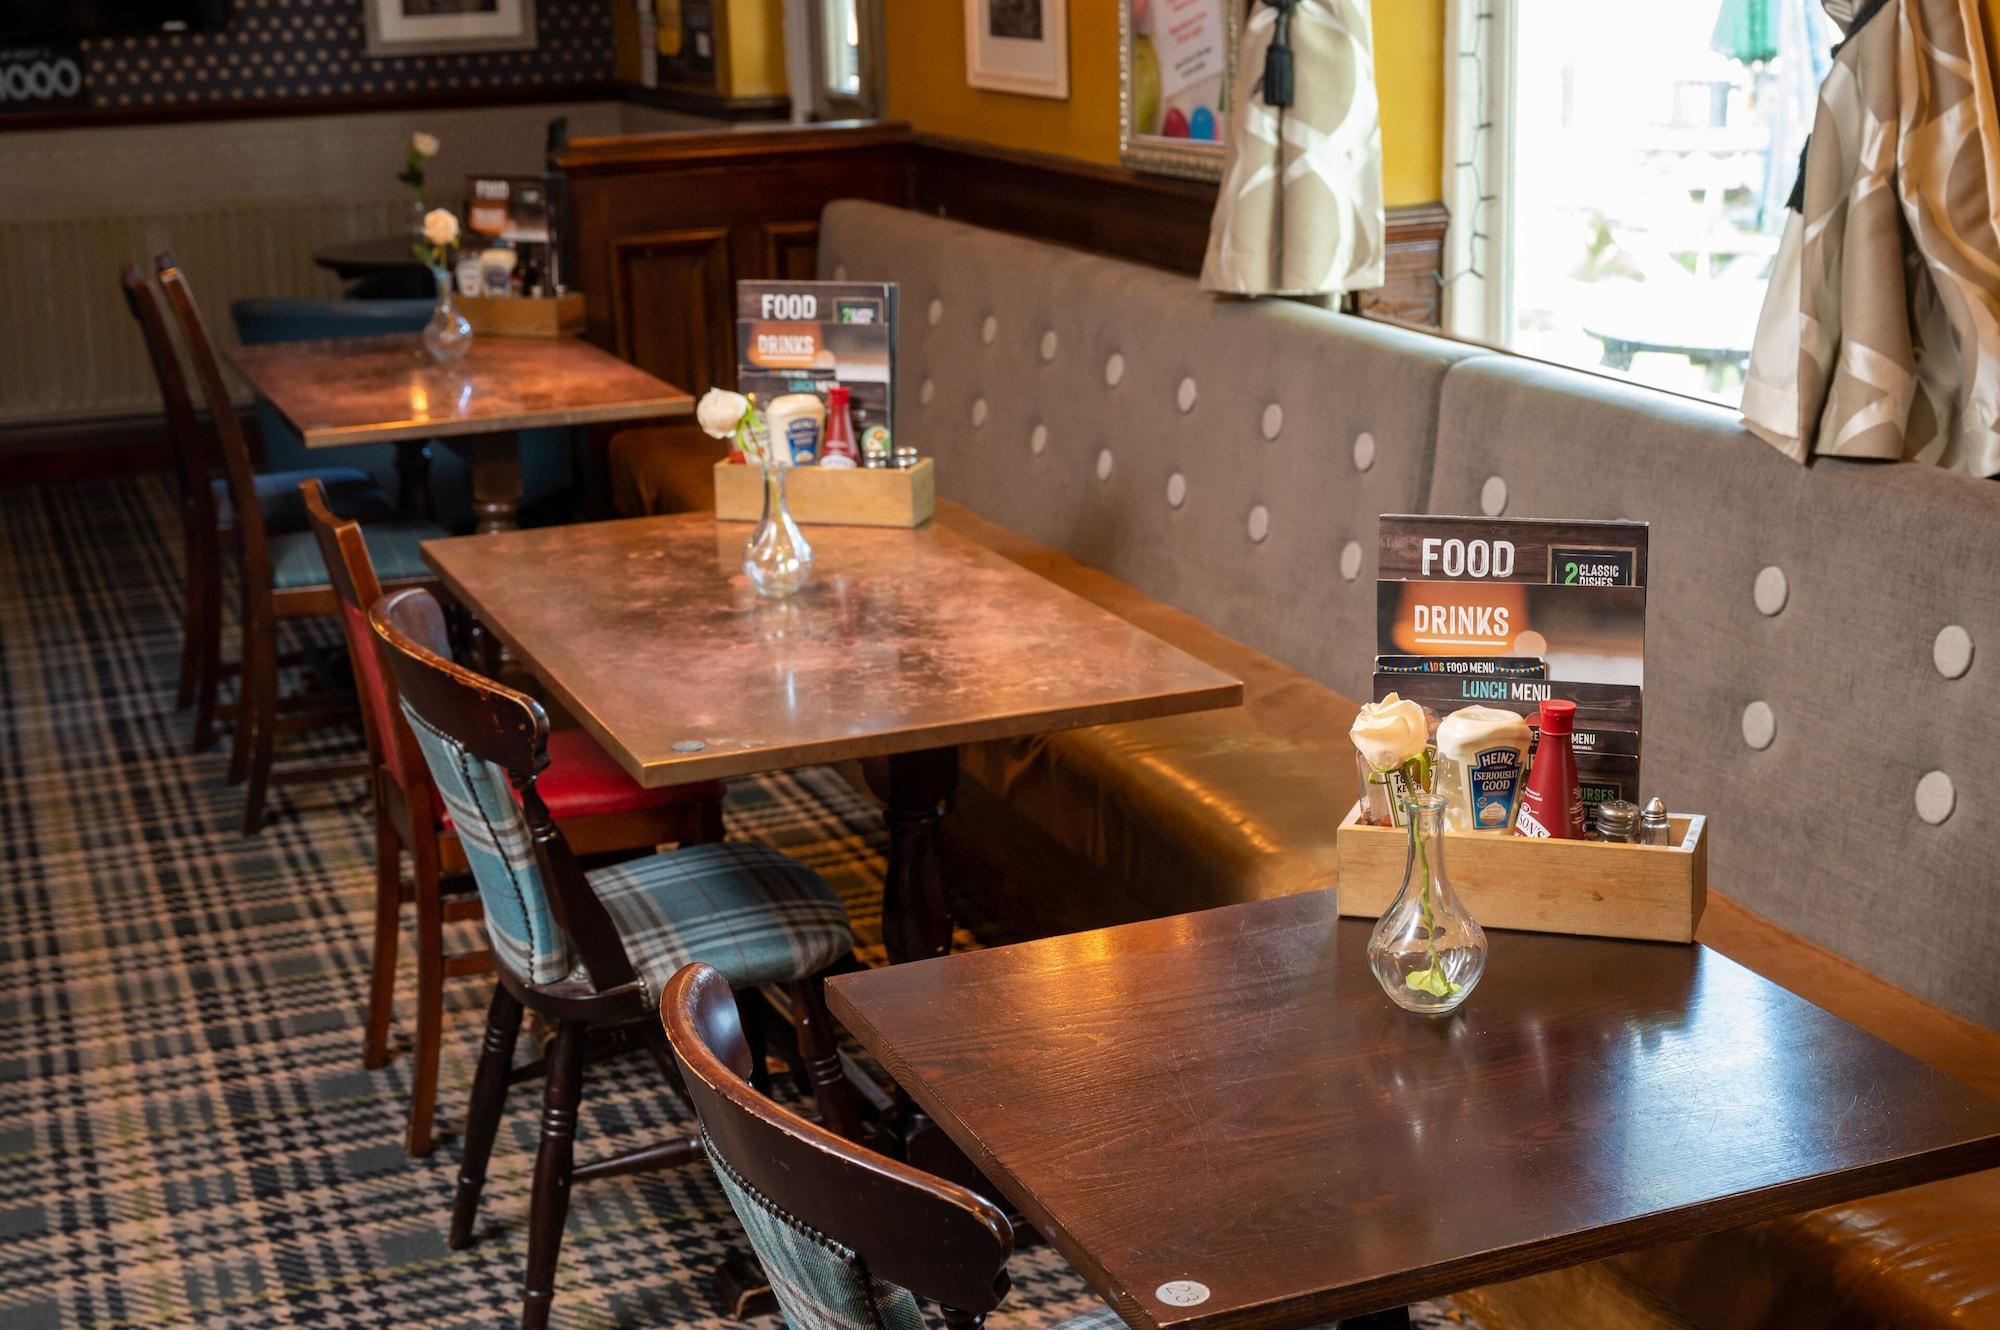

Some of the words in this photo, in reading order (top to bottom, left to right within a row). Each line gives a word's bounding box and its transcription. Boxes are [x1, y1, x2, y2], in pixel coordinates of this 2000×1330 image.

[761, 294, 818, 320] FOOD
[757, 335, 814, 355] DRINKS
[1422, 538, 1515, 578] FOOD
[1565, 562, 1579, 585] 2
[1579, 563, 1620, 578] CLASSIC
[1414, 604, 1510, 637] DRINKS
[1423, 661, 1445, 673] KIDS
[1446, 662, 1469, 674] FOOD
[1469, 662, 1495, 674] MENU
[1462, 680, 1507, 699] LUNCH
[1511, 682, 1552, 701] MENU
[1571, 732, 1596, 745] MENU
[1481, 751, 1516, 767] HEINZ
[1482, 779, 1511, 791] GOOD
[1580, 786, 1615, 801] URSES
